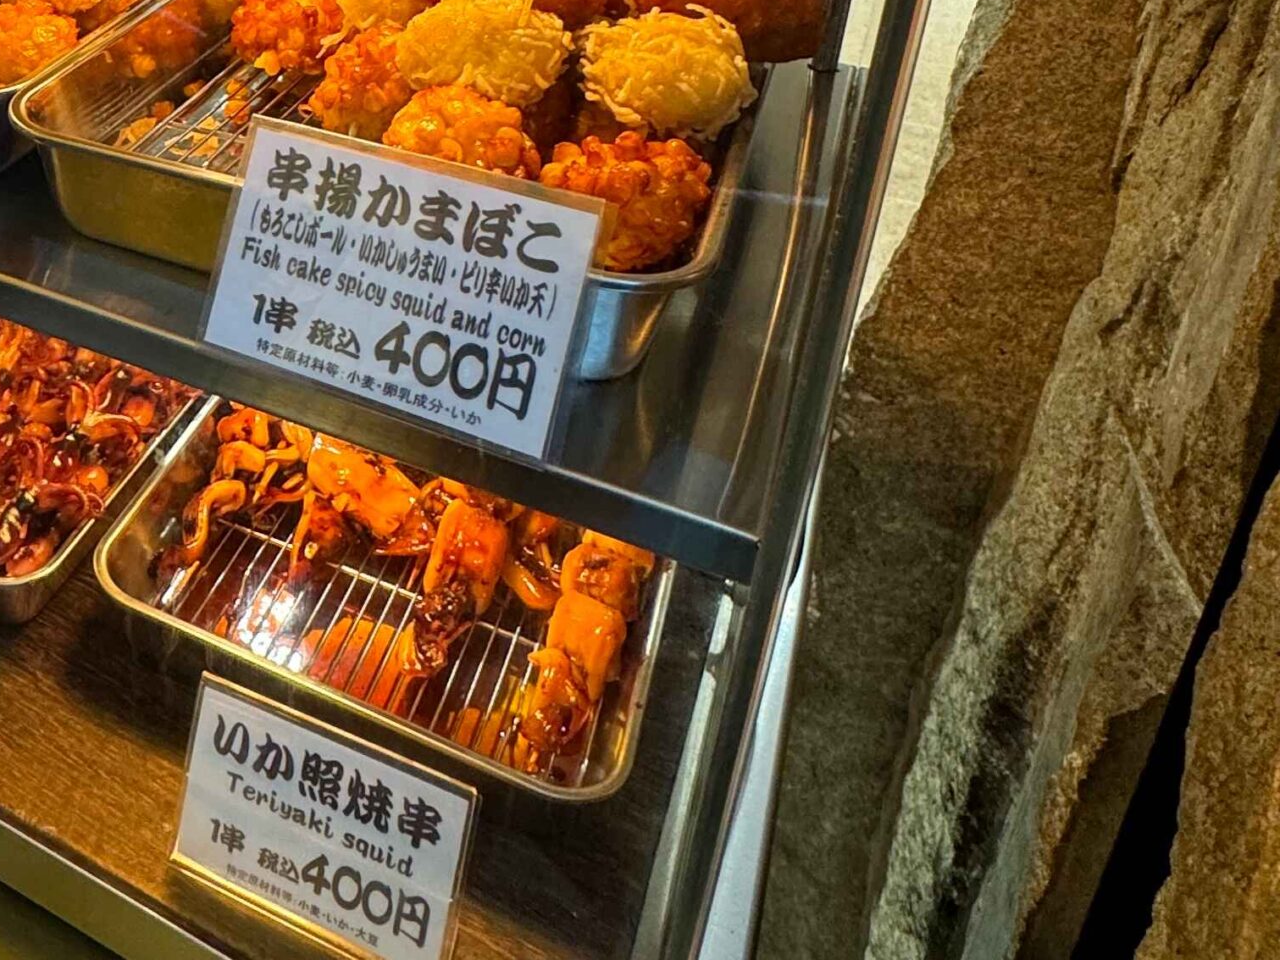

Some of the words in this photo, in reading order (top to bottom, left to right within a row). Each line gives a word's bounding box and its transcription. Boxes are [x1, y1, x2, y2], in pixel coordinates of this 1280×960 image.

[266, 146, 563, 274] 串揚かまぼこ
[240, 236, 281, 271] Fish
[287, 256, 332, 286] cake
[335, 271, 388, 308] spicy
[390, 288, 447, 323] squid
[452, 308, 493, 339] and
[496, 323, 547, 357] corn
[252, 294, 299, 334] 1串
[306, 319, 361, 360] 税込
[374, 321, 537, 421] 400円
[213, 714, 443, 849] いか照焼串
[226, 771, 334, 840] Teriyaki
[341, 831, 414, 878] squid
[210, 817, 246, 855] 1串
[257, 846, 301, 885] 税込
[300, 853, 431, 949] 400円
